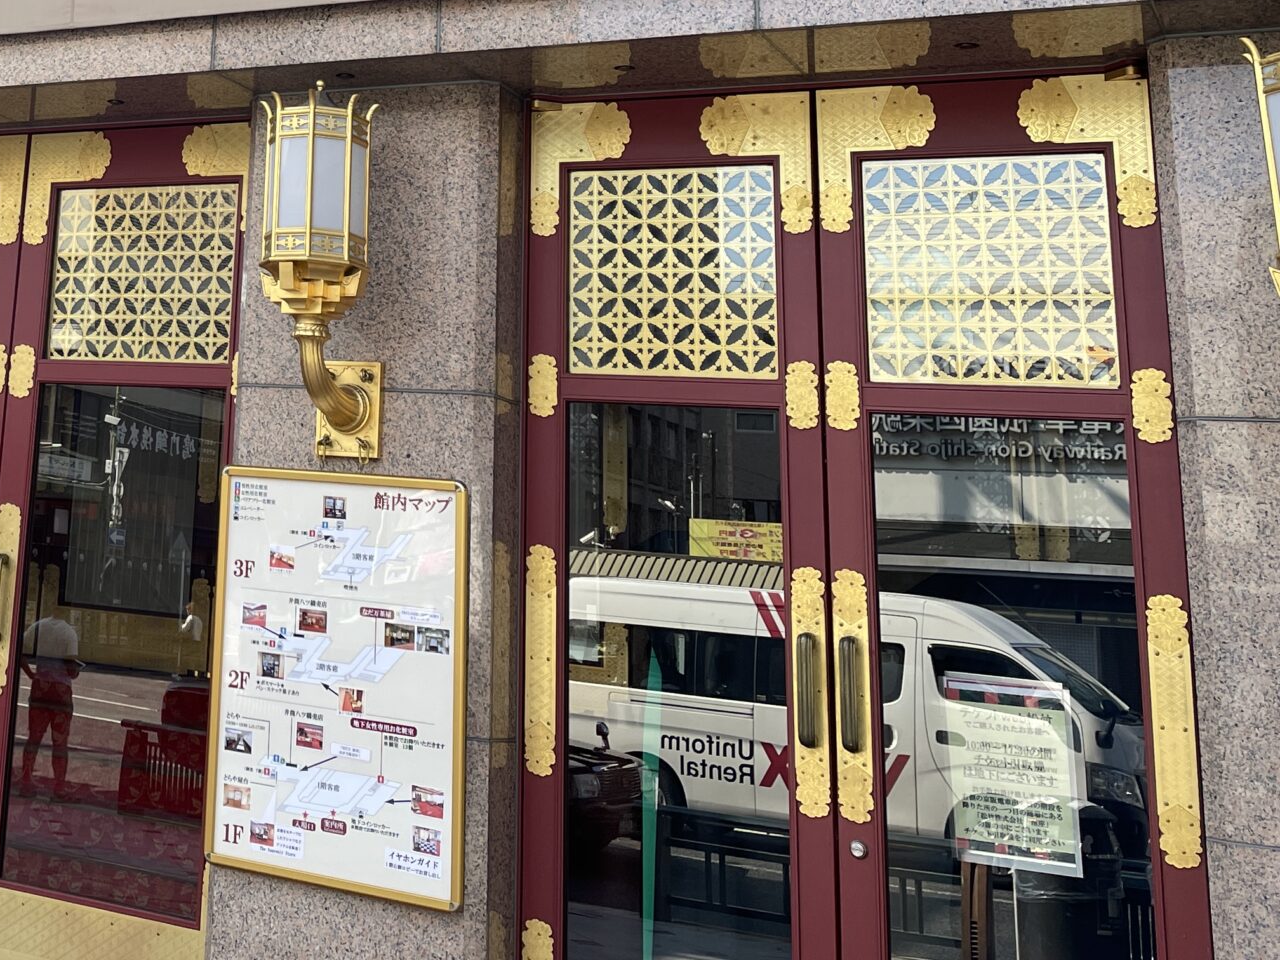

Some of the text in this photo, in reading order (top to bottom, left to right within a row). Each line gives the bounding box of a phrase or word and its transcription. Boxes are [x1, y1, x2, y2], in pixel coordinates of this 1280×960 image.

[374, 492, 453, 513] 館内マップ
[233, 559, 255, 578] 3F
[228, 670, 250, 689] 2F
[222, 823, 244, 844] 1F
[388, 851, 439, 869] イヤホンガイド
